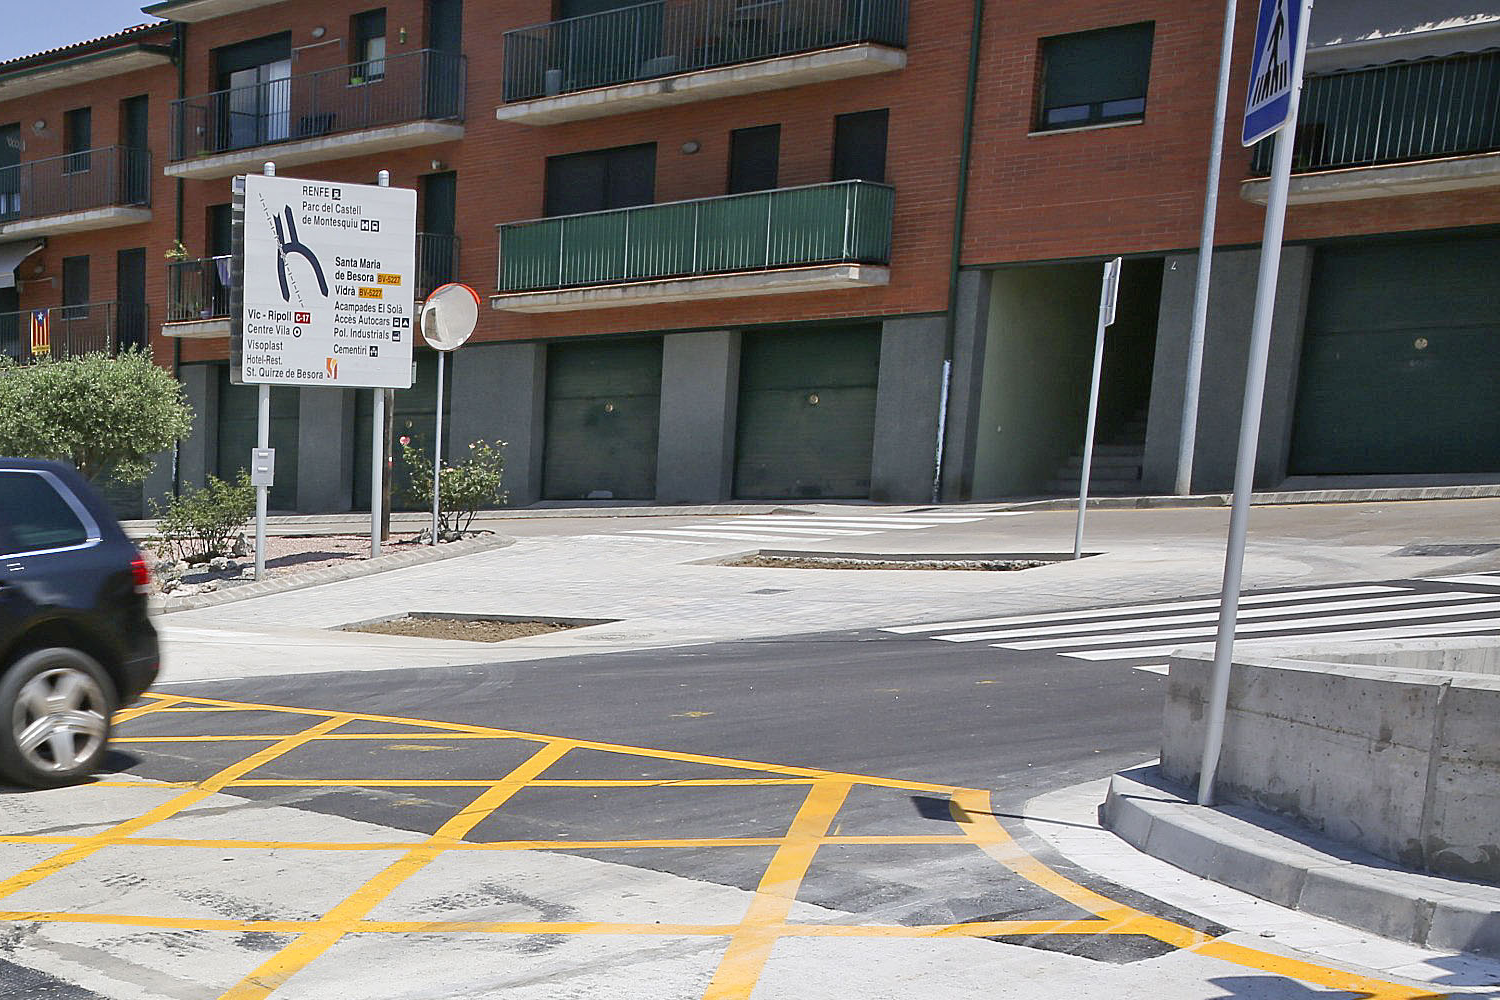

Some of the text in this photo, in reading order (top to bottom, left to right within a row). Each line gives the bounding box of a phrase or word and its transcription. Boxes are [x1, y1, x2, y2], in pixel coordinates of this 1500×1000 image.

[303, 186, 329, 197] RENFE
[303, 201, 361, 215] Parc del Castell
[302, 215, 358, 229] de Montesquiu
[335, 256, 381, 269] Santa Maria
[335, 271, 401, 283] de Besora BV-5227
[335, 285, 382, 297] Vidrà BV-5227
[335, 301, 403, 314] Acampades El Solà
[248, 309, 261, 319] Vic
[268, 310, 292, 323] Ripoll
[296, 314, 309, 322] C-17
[335, 314, 390, 326] Accès Autocars
[248, 324, 290, 335] Centre Vila
[334, 328, 389, 340] Pol. Industrials
[248, 339, 283, 352] Visoplast
[334, 344, 367, 355] Cementiri
[247, 354, 283, 365] Hotel-Rest.
[247, 367, 323, 379] St. Quirze de Besora
